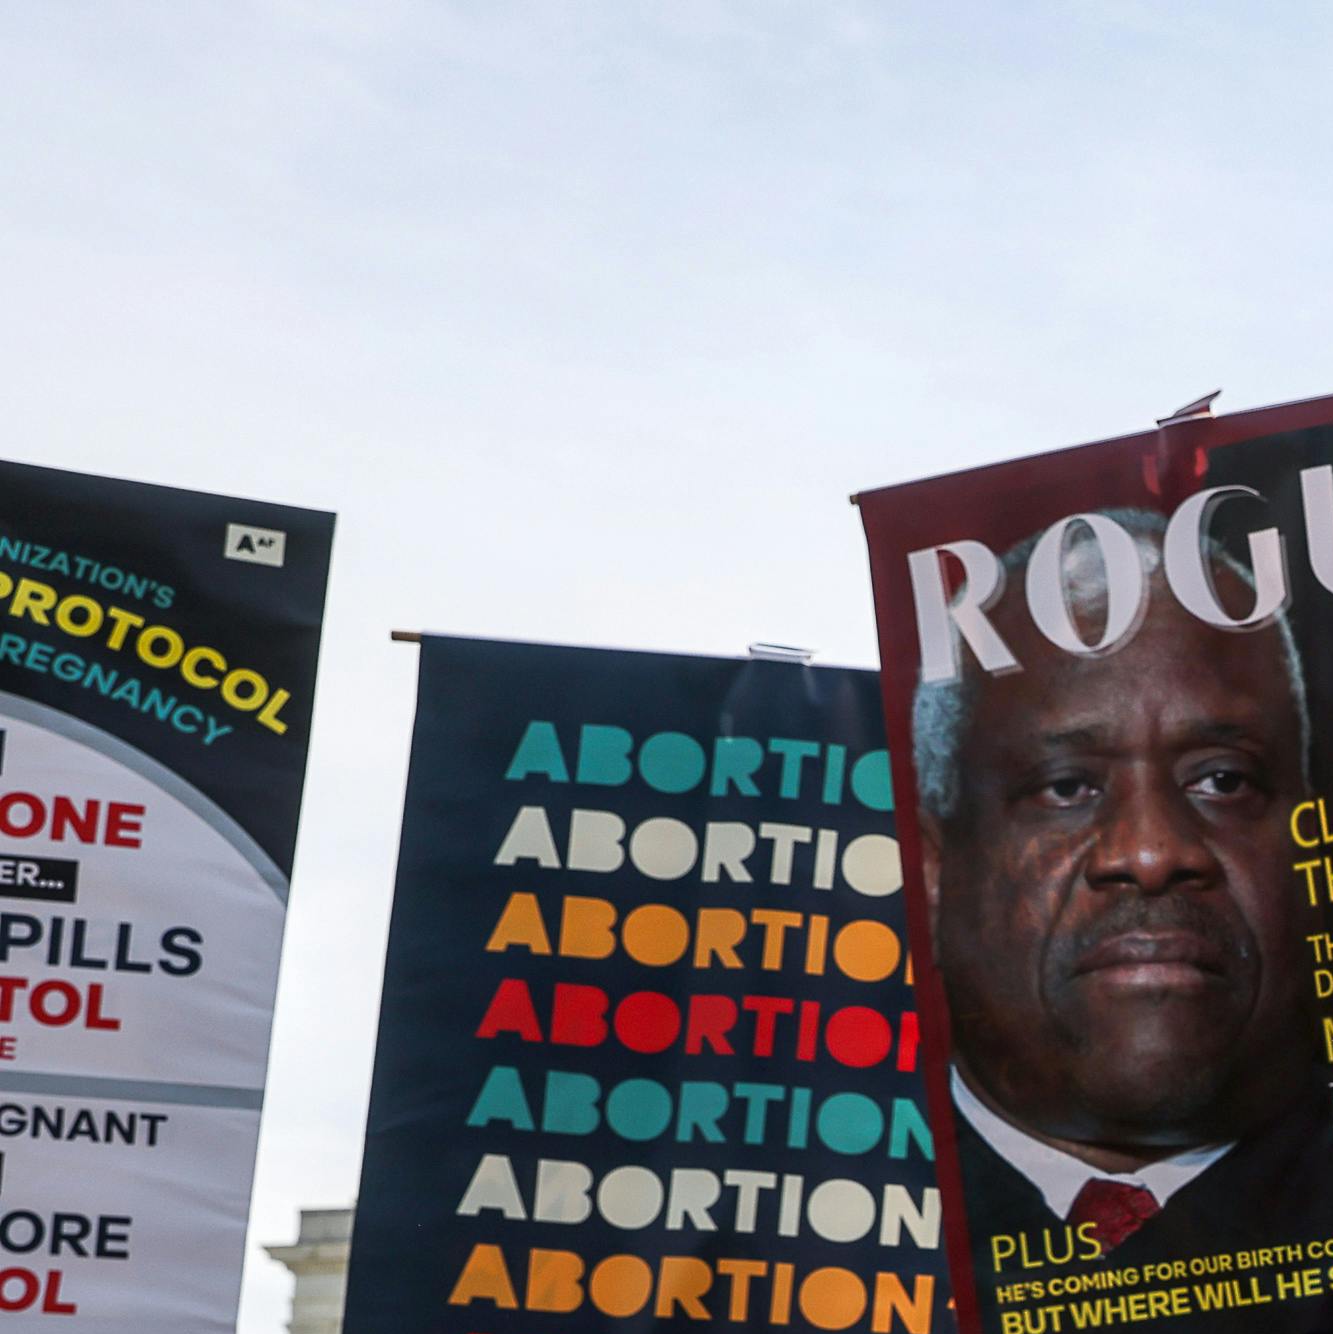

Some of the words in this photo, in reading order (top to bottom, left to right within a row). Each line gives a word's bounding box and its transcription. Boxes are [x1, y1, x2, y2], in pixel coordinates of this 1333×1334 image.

[485, 891, 915, 986] ABORTIO
[456, 1154, 941, 1250] ABORTION
[990, 1221, 1103, 1273] PLUS
[996, 1280, 1044, 1305] HE'S
[1047, 1268, 1138, 1297] COMING
[1143, 1259, 1188, 1281] FOR
[1189, 1252, 1234, 1276] OUR
[1236, 1242, 1303, 1271] BIRTH
[1071, 1292, 1191, 1330] WHERE
[1195, 1276, 1272, 1311] WILL
[1275, 1272, 1323, 1300] HE
